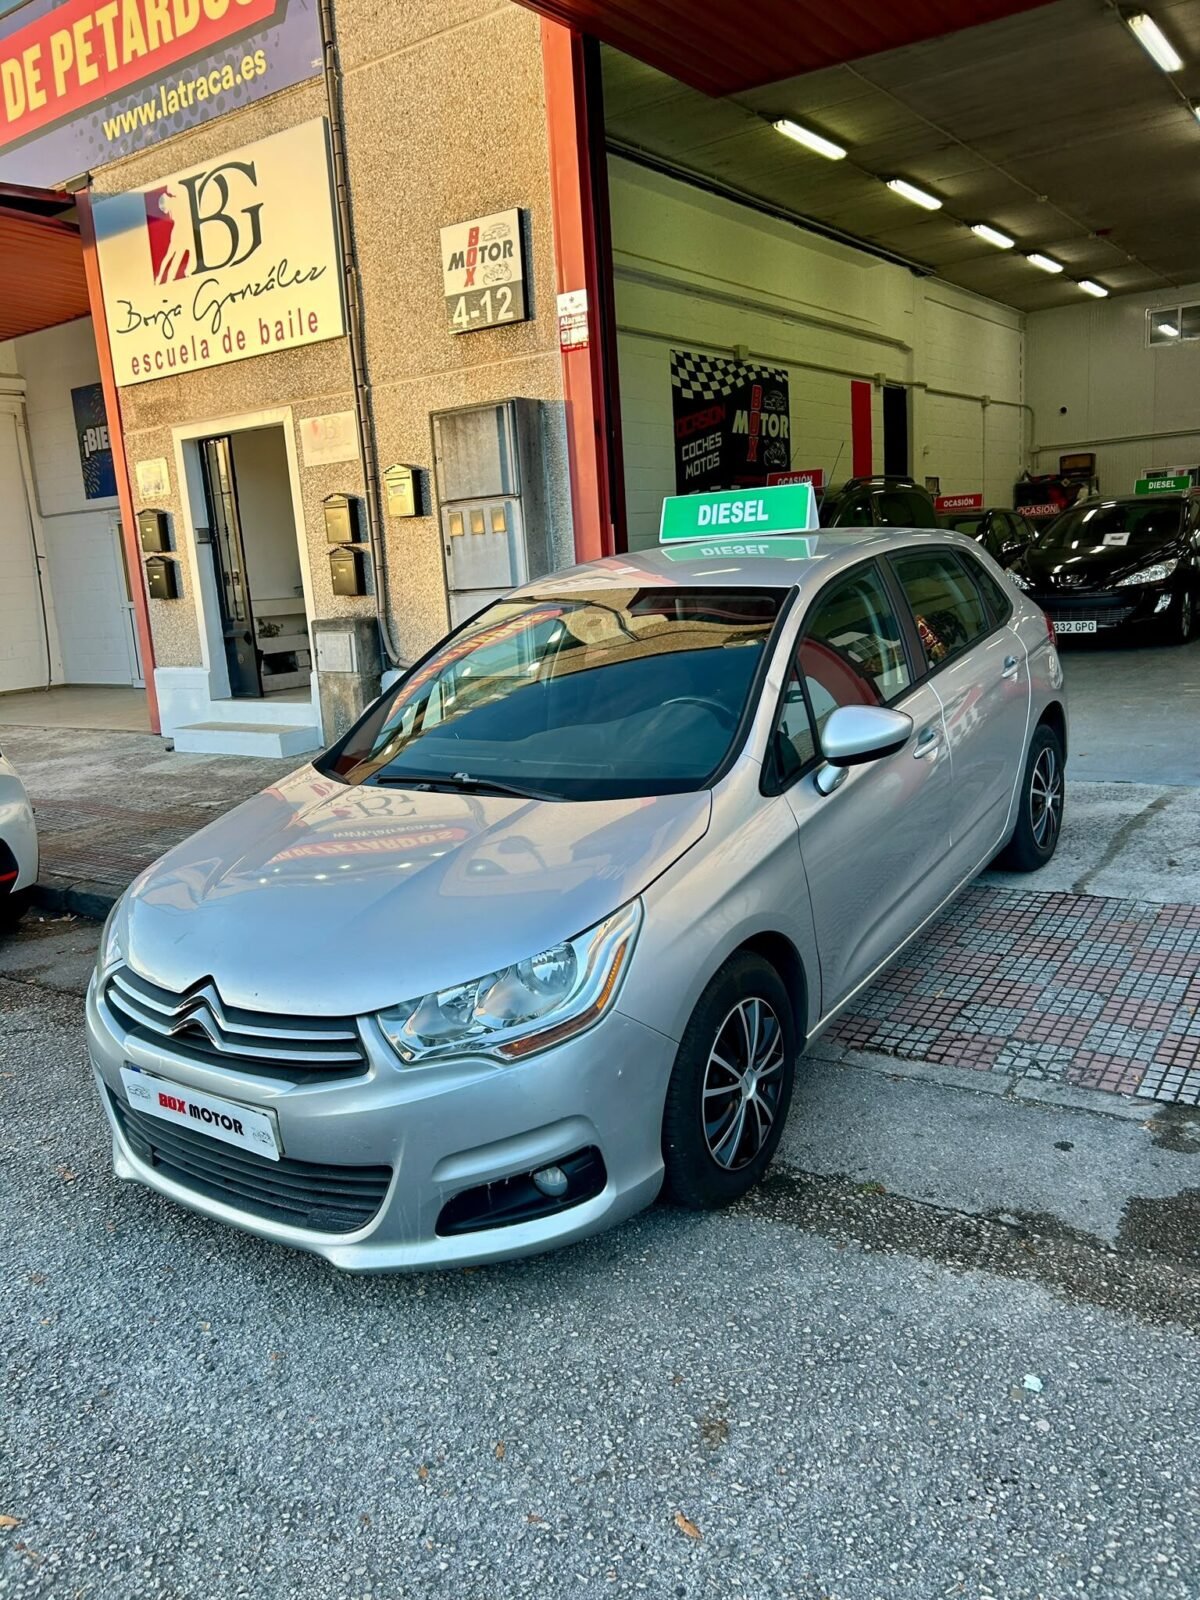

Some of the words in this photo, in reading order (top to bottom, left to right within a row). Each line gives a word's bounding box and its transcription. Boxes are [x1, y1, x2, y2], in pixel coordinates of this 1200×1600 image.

[1, 44, 47, 123] DE
[103, 49, 267, 141] www.latraca.es
[178, 160, 264, 275] BG
[463, 226, 480, 288] BOX
[116, 300, 182, 340] Borja
[193, 258, 327, 334] González
[452, 286, 514, 329] 4-12
[131, 335, 210, 375] escuela
[222, 326, 247, 354] de
[259, 307, 319, 345] baile
[681, 432, 723, 461] COCHES
[685, 451, 720, 480] MOTOS
[1148, 480, 1176, 489] DIESEL
[697, 500, 769, 526] DIESEL
[1075, 622, 1095, 632] GPG
[158, 1092, 186, 1114] BOX
[188, 1103, 244, 1136] MOTOR
